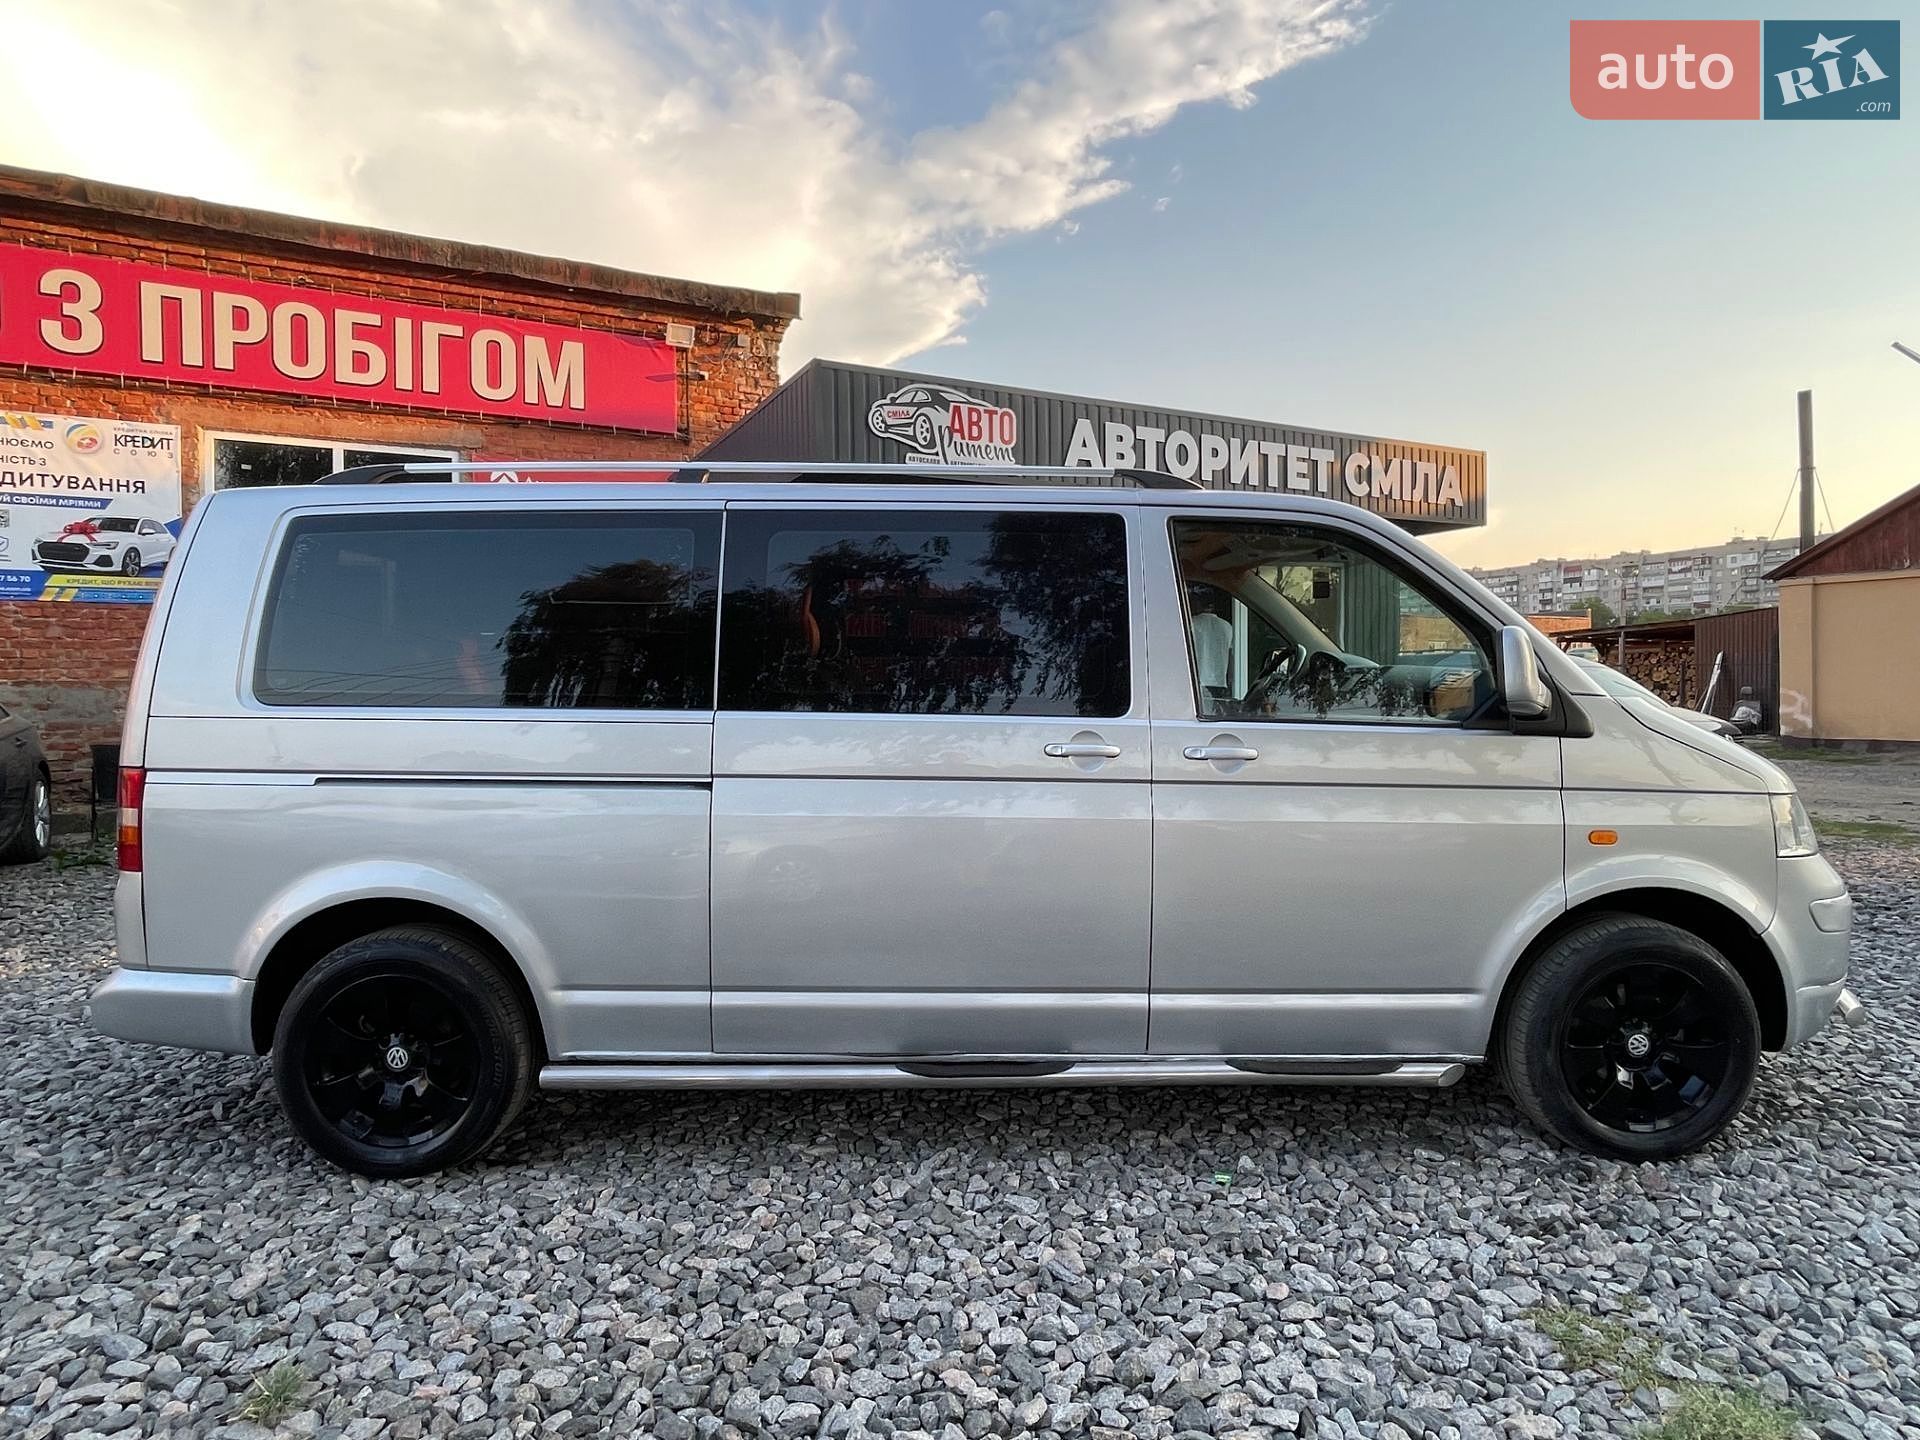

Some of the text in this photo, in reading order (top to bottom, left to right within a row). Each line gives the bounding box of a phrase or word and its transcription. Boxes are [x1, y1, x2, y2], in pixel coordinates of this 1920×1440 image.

[40, 268, 586, 410] З ПРОБІГОМ
[950, 405, 1015, 445] АВТО
[0, 471, 146, 494] ДИТУВАННЯ
[1064, 418, 1464, 507] АВТОРИТЕТ СМІЛА
[13, 495, 57, 505] СВОЇМИ
[58, 499, 101, 508] МРІЯМИ
